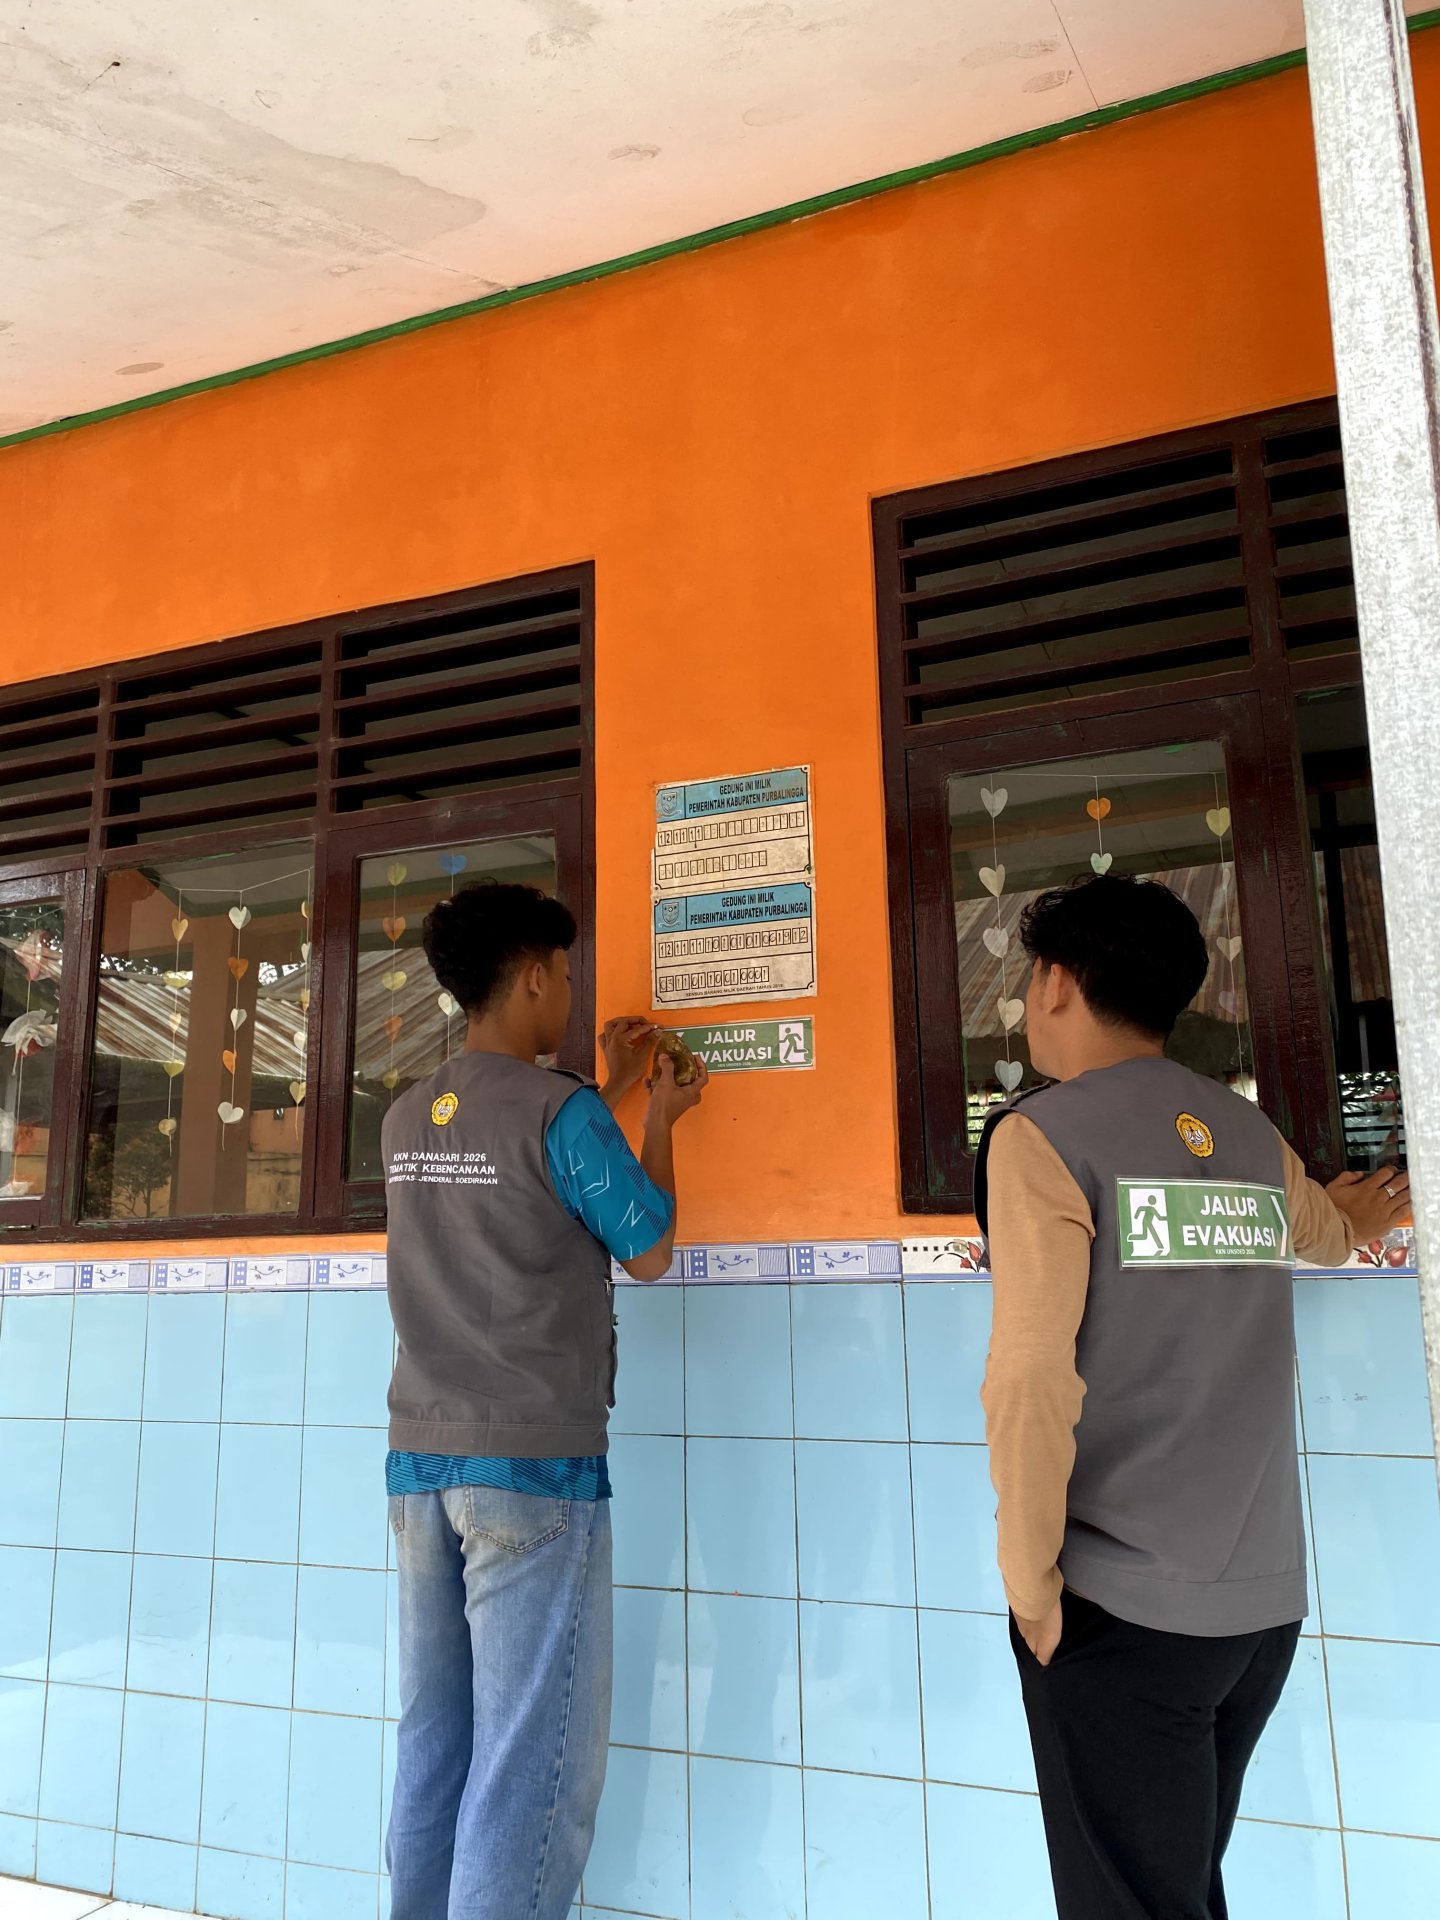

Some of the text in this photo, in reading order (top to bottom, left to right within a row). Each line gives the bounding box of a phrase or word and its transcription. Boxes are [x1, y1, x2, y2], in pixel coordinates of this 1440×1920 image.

[719, 778, 772, 796] GEDUNG INI MILIK
[688, 787, 804, 813] PEMERINTAH KABUPATEN PURBALINGGA
[721, 891, 775, 907] GEDUNG INI MILIK
[690, 901, 808, 925] PEMERINTAH KABUPATEN PURBALINGGA
[704, 1029, 756, 1045] JALUR
[691, 1047, 772, 1063] VAKUASI
[393, 1152, 486, 1162] KKN DANASARI 2026
[422, 1163, 495, 1175] KEBENCANAAN
[418, 1175, 453, 1184] JENDERAL
[455, 1177, 498, 1185] SOEDIRMAN
[1200, 1195, 1259, 1217] JALUR
[1182, 1225, 1276, 1248] EVAKUASI
